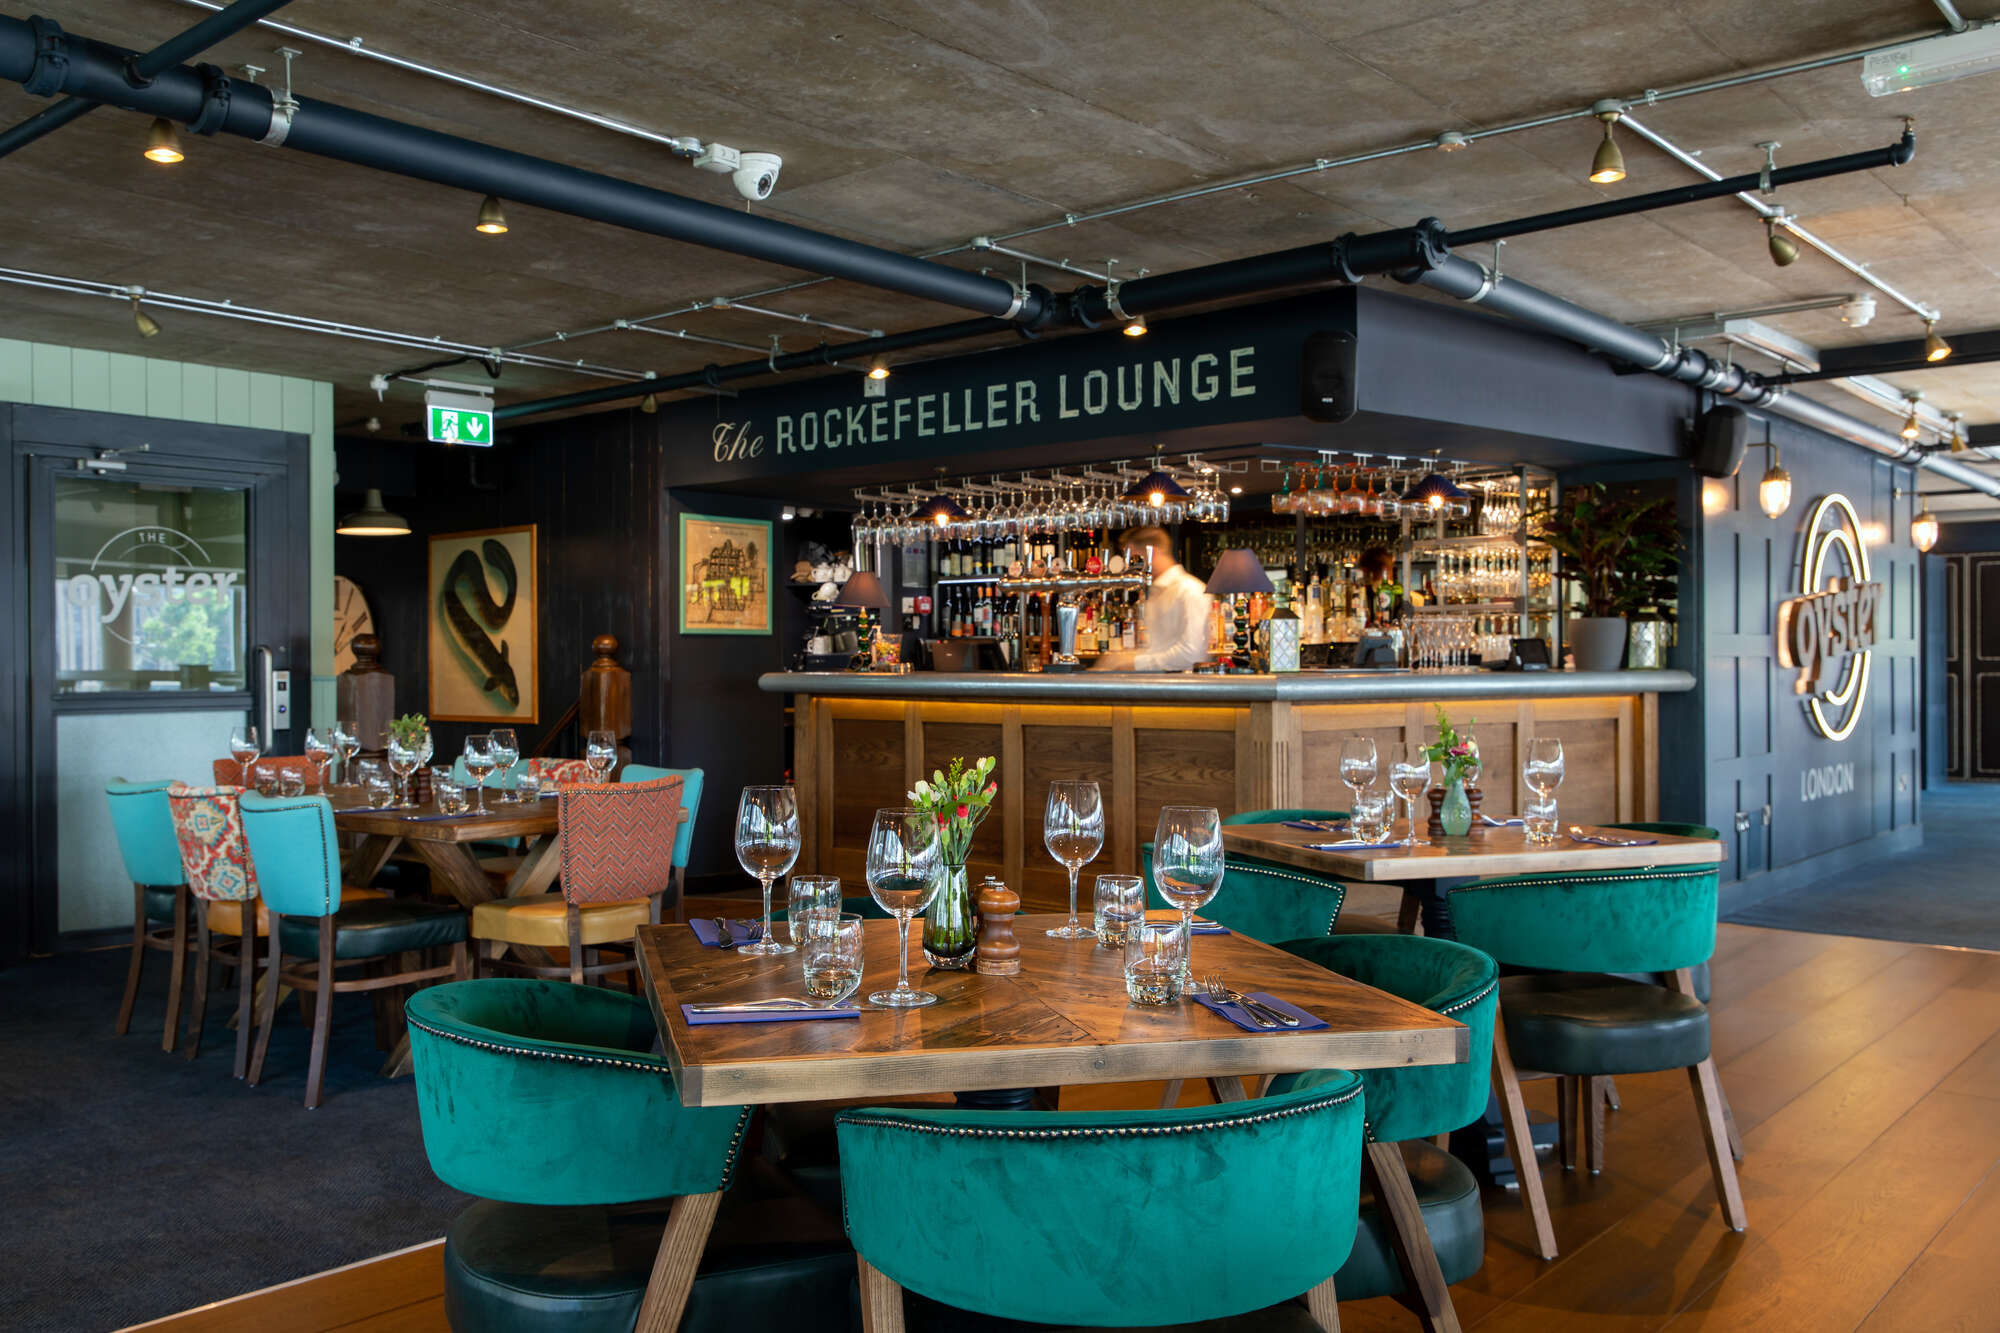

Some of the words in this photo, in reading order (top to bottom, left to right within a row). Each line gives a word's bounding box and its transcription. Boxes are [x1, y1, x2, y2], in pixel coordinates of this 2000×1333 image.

[711, 420, 765, 463] The
[776, 380, 1041, 455] ROCKEFELLER
[1059, 346, 1257, 420] LOUNGE
[138, 532, 167, 544] THE
[68, 566, 237, 624] oyster
[1800, 761, 1855, 802] LONDON
